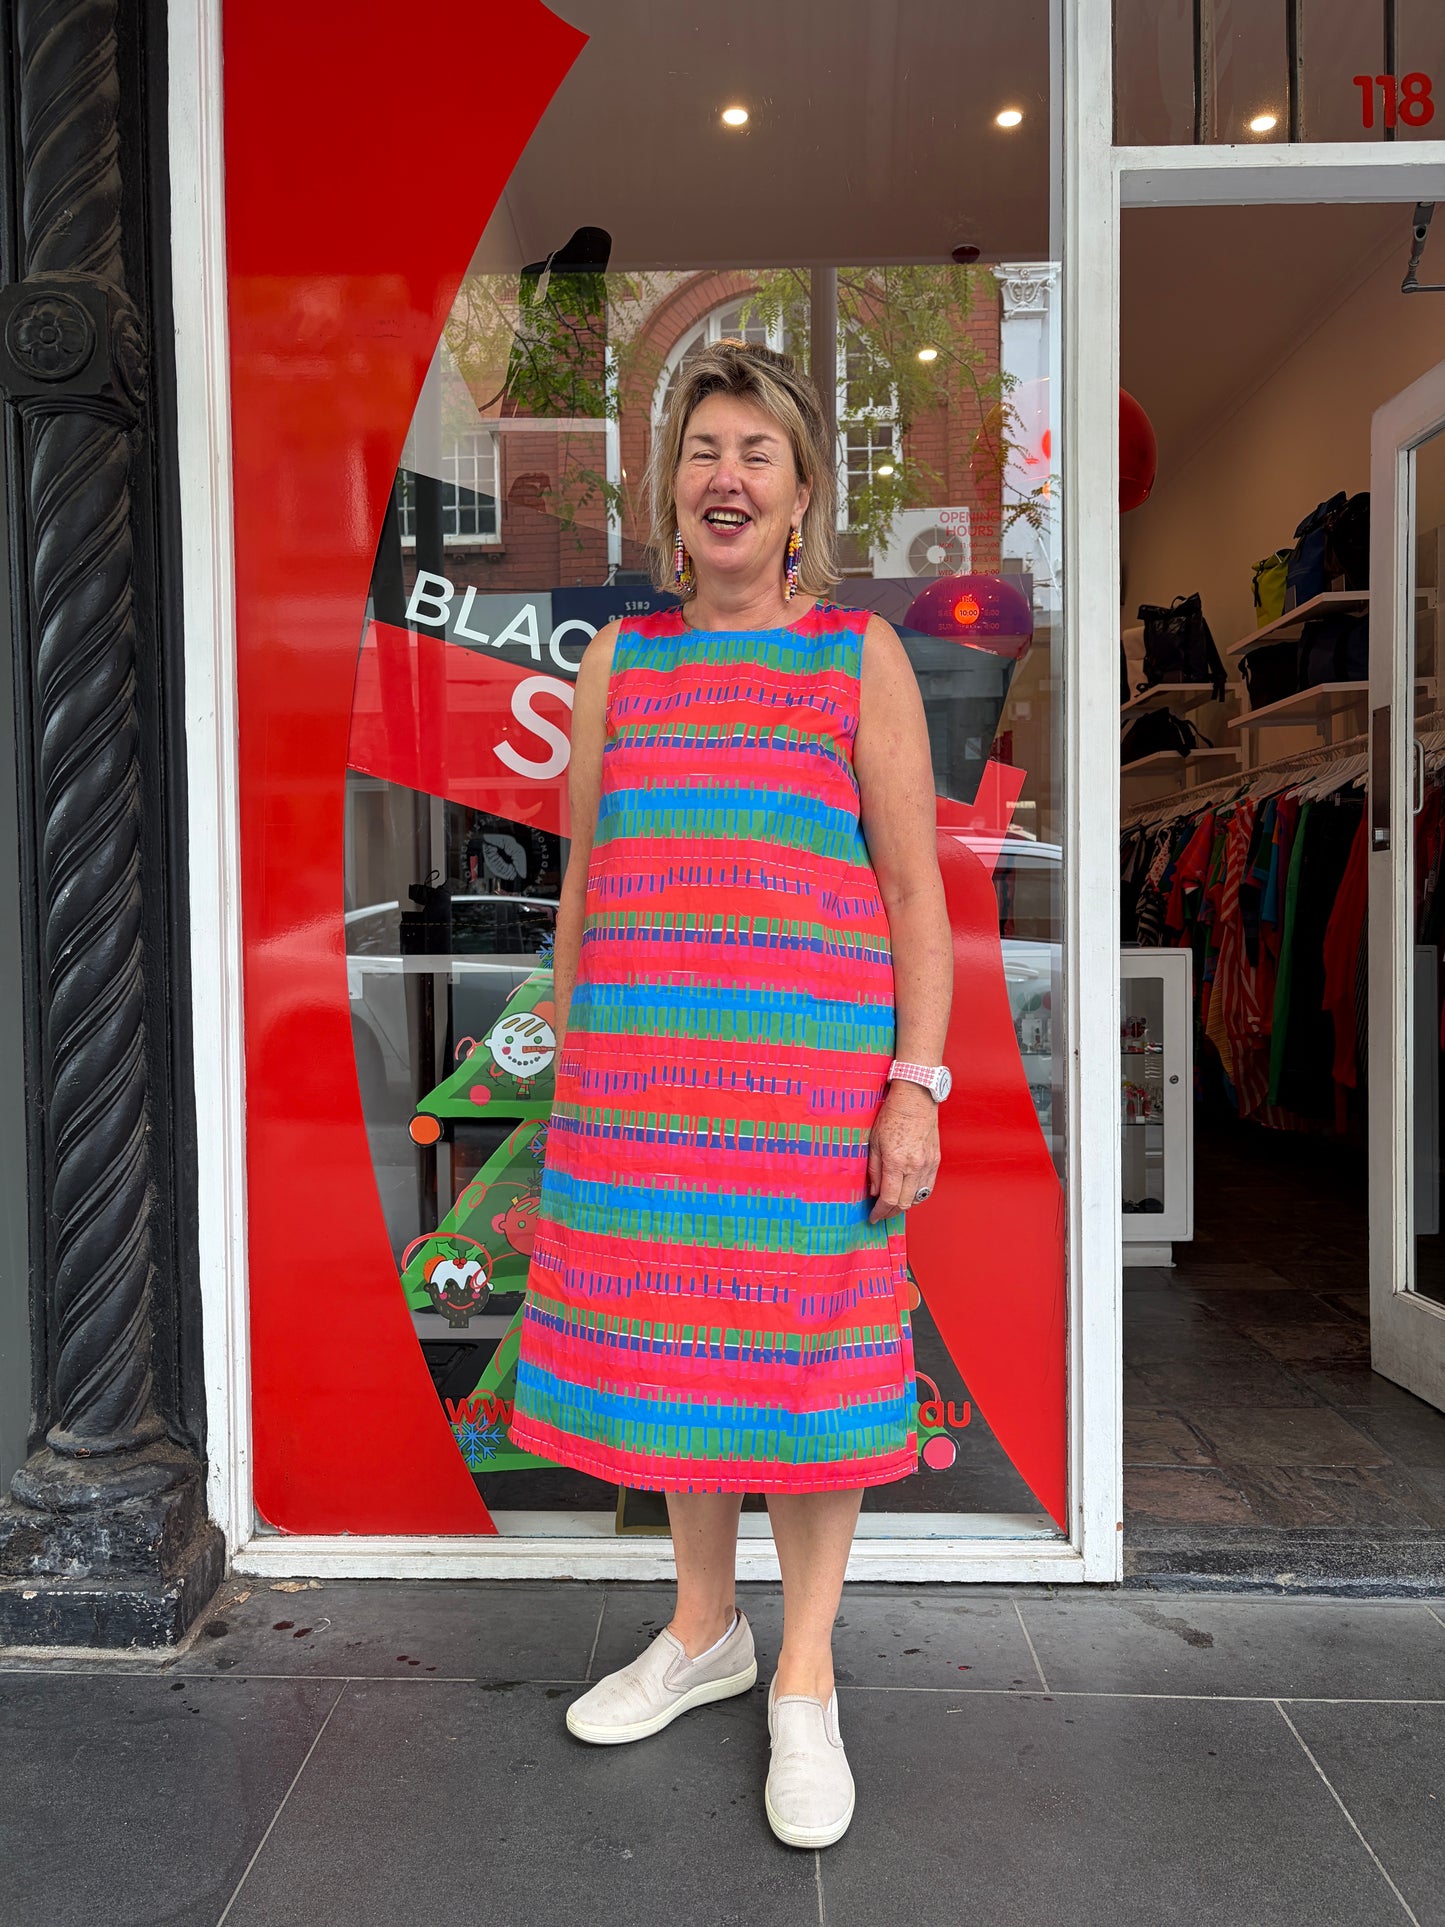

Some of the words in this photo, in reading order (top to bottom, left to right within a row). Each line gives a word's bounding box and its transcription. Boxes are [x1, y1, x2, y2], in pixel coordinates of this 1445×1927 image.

[1353, 72, 1435, 129] 118
[940, 511, 1001, 524] OPENING
[946, 525, 994, 537] HOURS
[960, 609, 978, 617] 10:00
[918, 1400, 972, 1428] au
